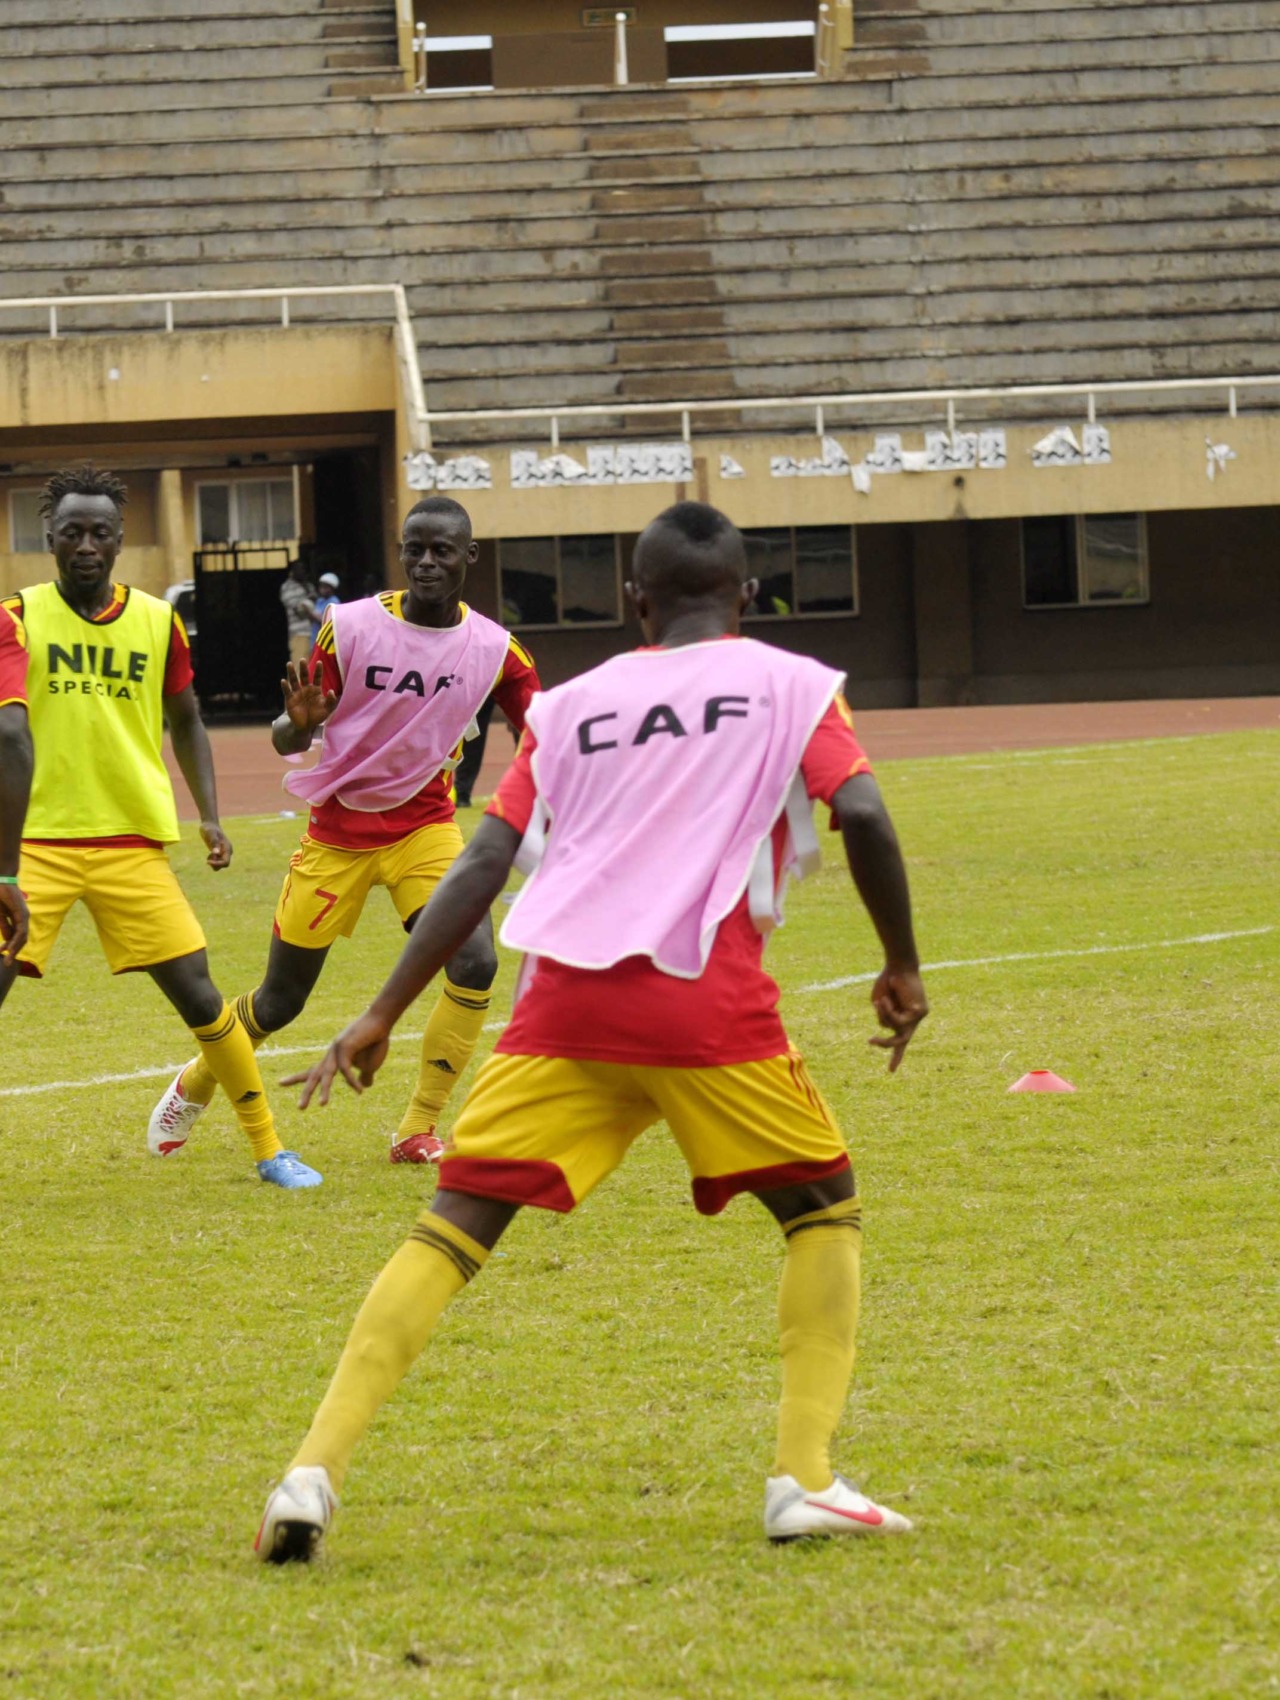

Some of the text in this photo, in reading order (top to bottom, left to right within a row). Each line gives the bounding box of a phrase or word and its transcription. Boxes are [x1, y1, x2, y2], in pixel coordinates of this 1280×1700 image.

[47, 642, 149, 683] NILE
[48, 680, 139, 700] SPECIA
[578, 695, 750, 755] CAF
[308, 887, 339, 931] 7
